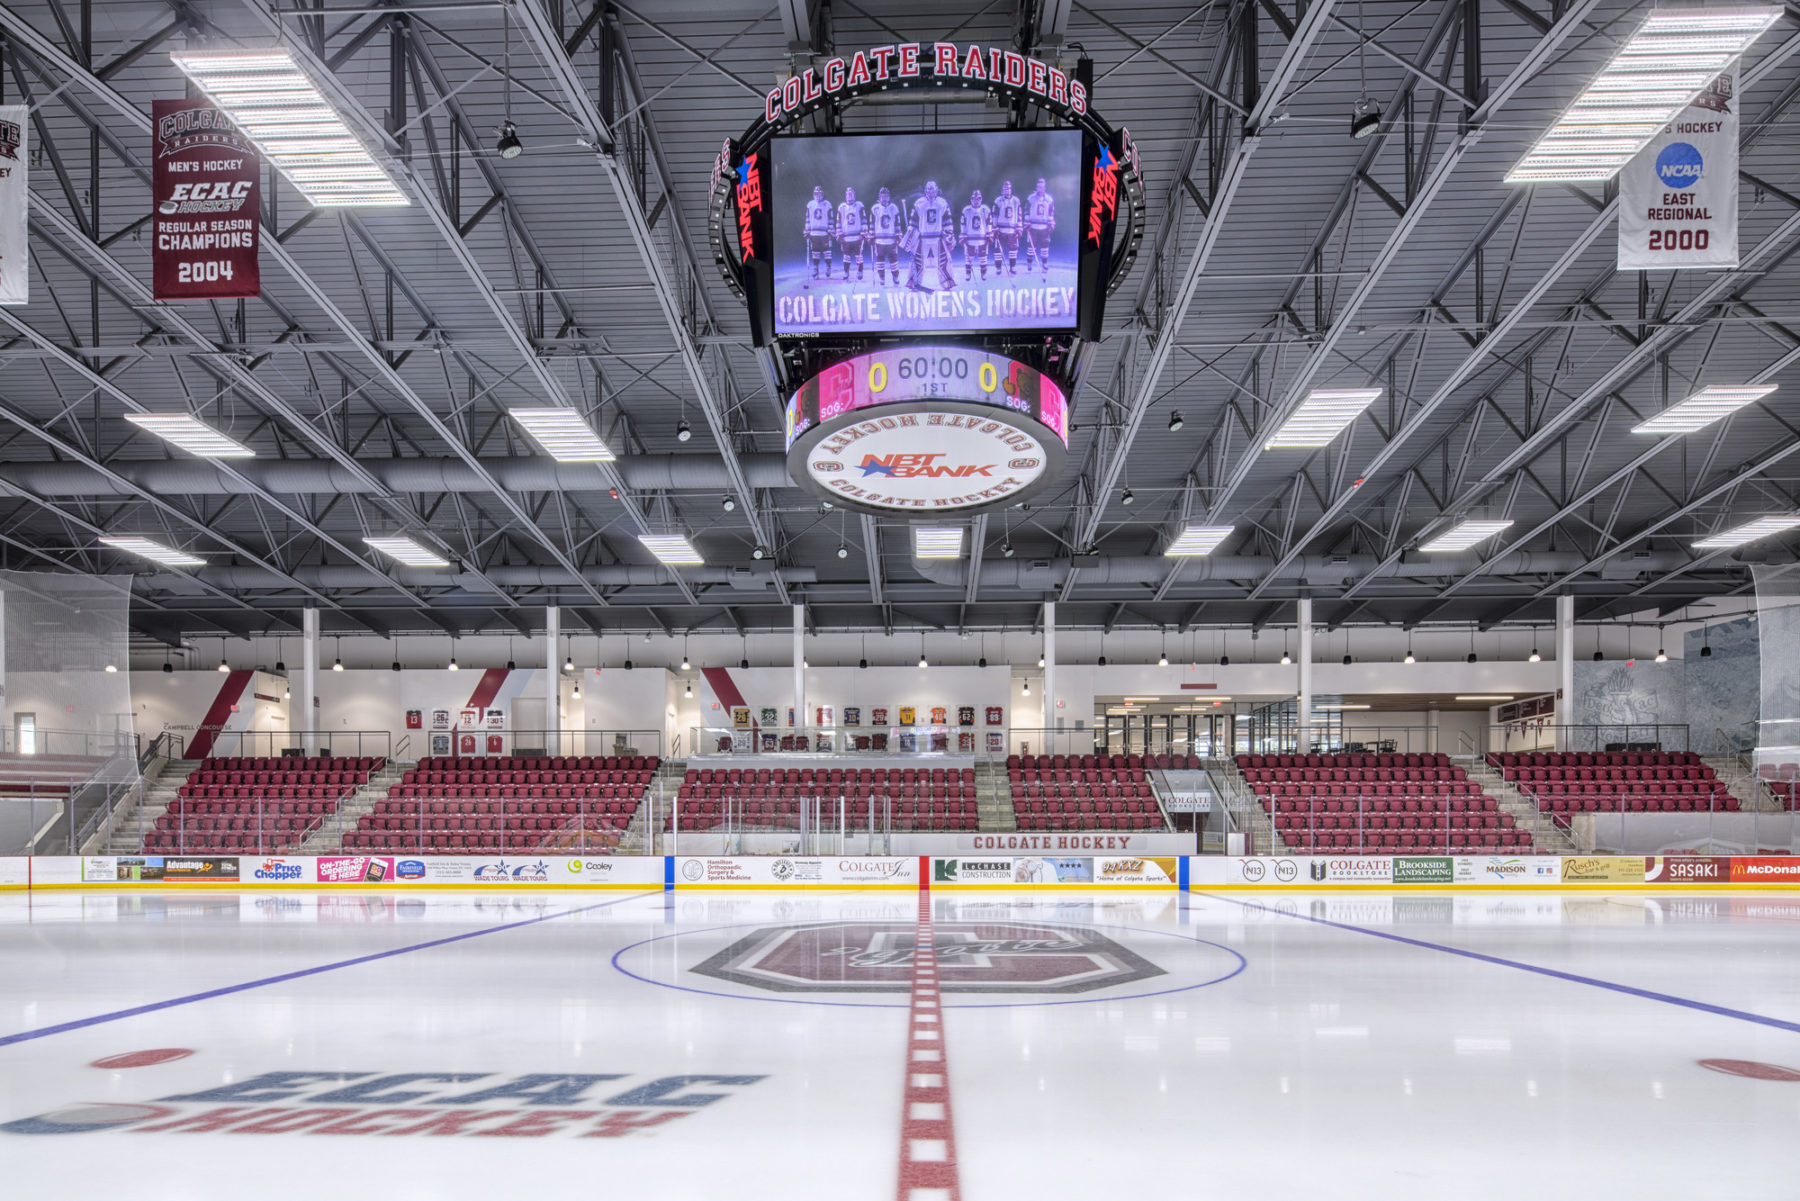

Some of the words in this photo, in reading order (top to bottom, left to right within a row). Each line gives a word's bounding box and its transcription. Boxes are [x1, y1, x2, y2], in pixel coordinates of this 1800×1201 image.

[765, 42, 920, 124] COLGATE
[934, 42, 1087, 116] RAIDERS
[161, 111, 236, 138] COLGA
[1677, 121, 1723, 134] HOCKEY
[174, 135, 238, 148] RAIDERS
[168, 161, 200, 173] MEN'S
[203, 159, 244, 172] HOCKEY
[1661, 164, 1701, 177] NCAA
[745, 152, 762, 212] NBT
[169, 181, 253, 201] ECAC
[177, 198, 246, 214] HOCKEY
[1088, 156, 1105, 249] BANK
[1663, 193, 1696, 205] EAST
[1648, 207, 1712, 220] REGIONAL
[159, 221, 207, 233] REGULAR
[211, 219, 253, 231] SEASON
[736, 183, 755, 264] BANK
[158, 231, 253, 251] CHAMPIONS
[1648, 229, 1709, 251] 2000
[178, 260, 234, 283] 2004
[779, 293, 881, 324] COLGATE
[886, 290, 981, 320] WOMENS
[986, 286, 1075, 318] HOCKEY
[868, 362, 888, 394] 0
[898, 356, 968, 379] 60:00
[979, 362, 998, 394] 0
[921, 382, 949, 397] 1ST
[820, 402, 844, 418] SOG:
[861, 453, 947, 469] NBT
[885, 464, 999, 478] BANK
[829, 479, 927, 507] COLGATE
[933, 476, 1023, 507] HOCKEY
[973, 836, 1051, 850] COLGATE
[1058, 836, 1131, 850] HOCKEY
[166, 860, 204, 870] Advantage
[274, 862, 302, 873] Price
[585, 861, 613, 872] Cooley
[1246, 867, 1262, 876] N13
[1278, 867, 1294, 876] N13
[1329, 860, 1391, 871] COLGATE
[1486, 865, 1526, 873] MADISON
[1669, 863, 1718, 877] SASAKI
[254, 869, 301, 881] Chopper
[962, 871, 1012, 879] CONSTRUCTION
[150, 1071, 772, 1107] ECAC
[126, 1107, 700, 1138] HOCKEY
